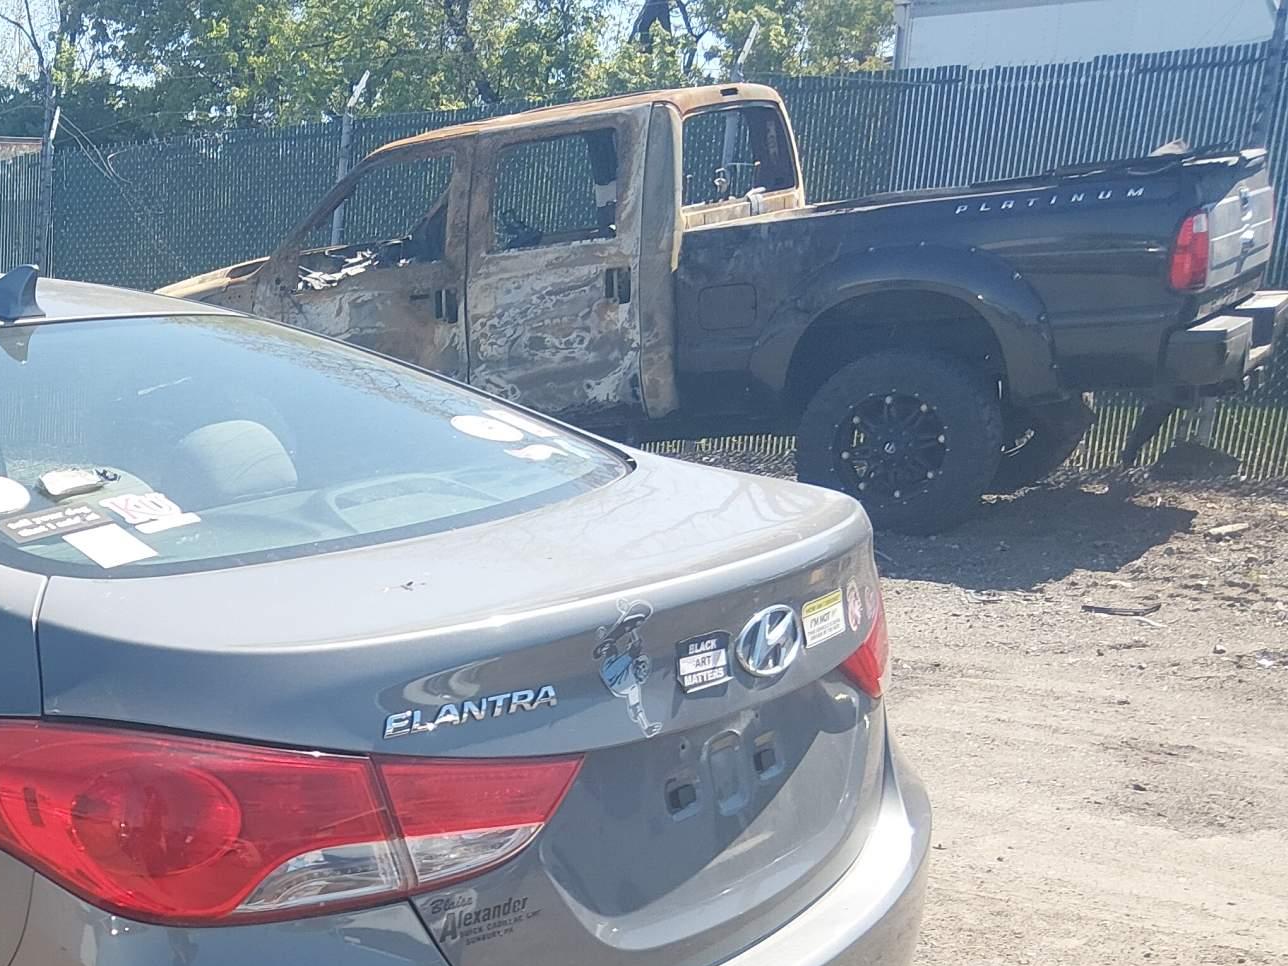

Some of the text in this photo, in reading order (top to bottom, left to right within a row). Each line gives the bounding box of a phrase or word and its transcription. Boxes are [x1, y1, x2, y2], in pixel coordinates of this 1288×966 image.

[955, 186, 1146, 214] PLATINUM
[688, 638, 718, 655] BLACK
[695, 655, 712, 668] ART
[683, 668, 725, 687] MATTERS
[382, 684, 558, 740] ELANTRA
[439, 896, 529, 944] Alexander
